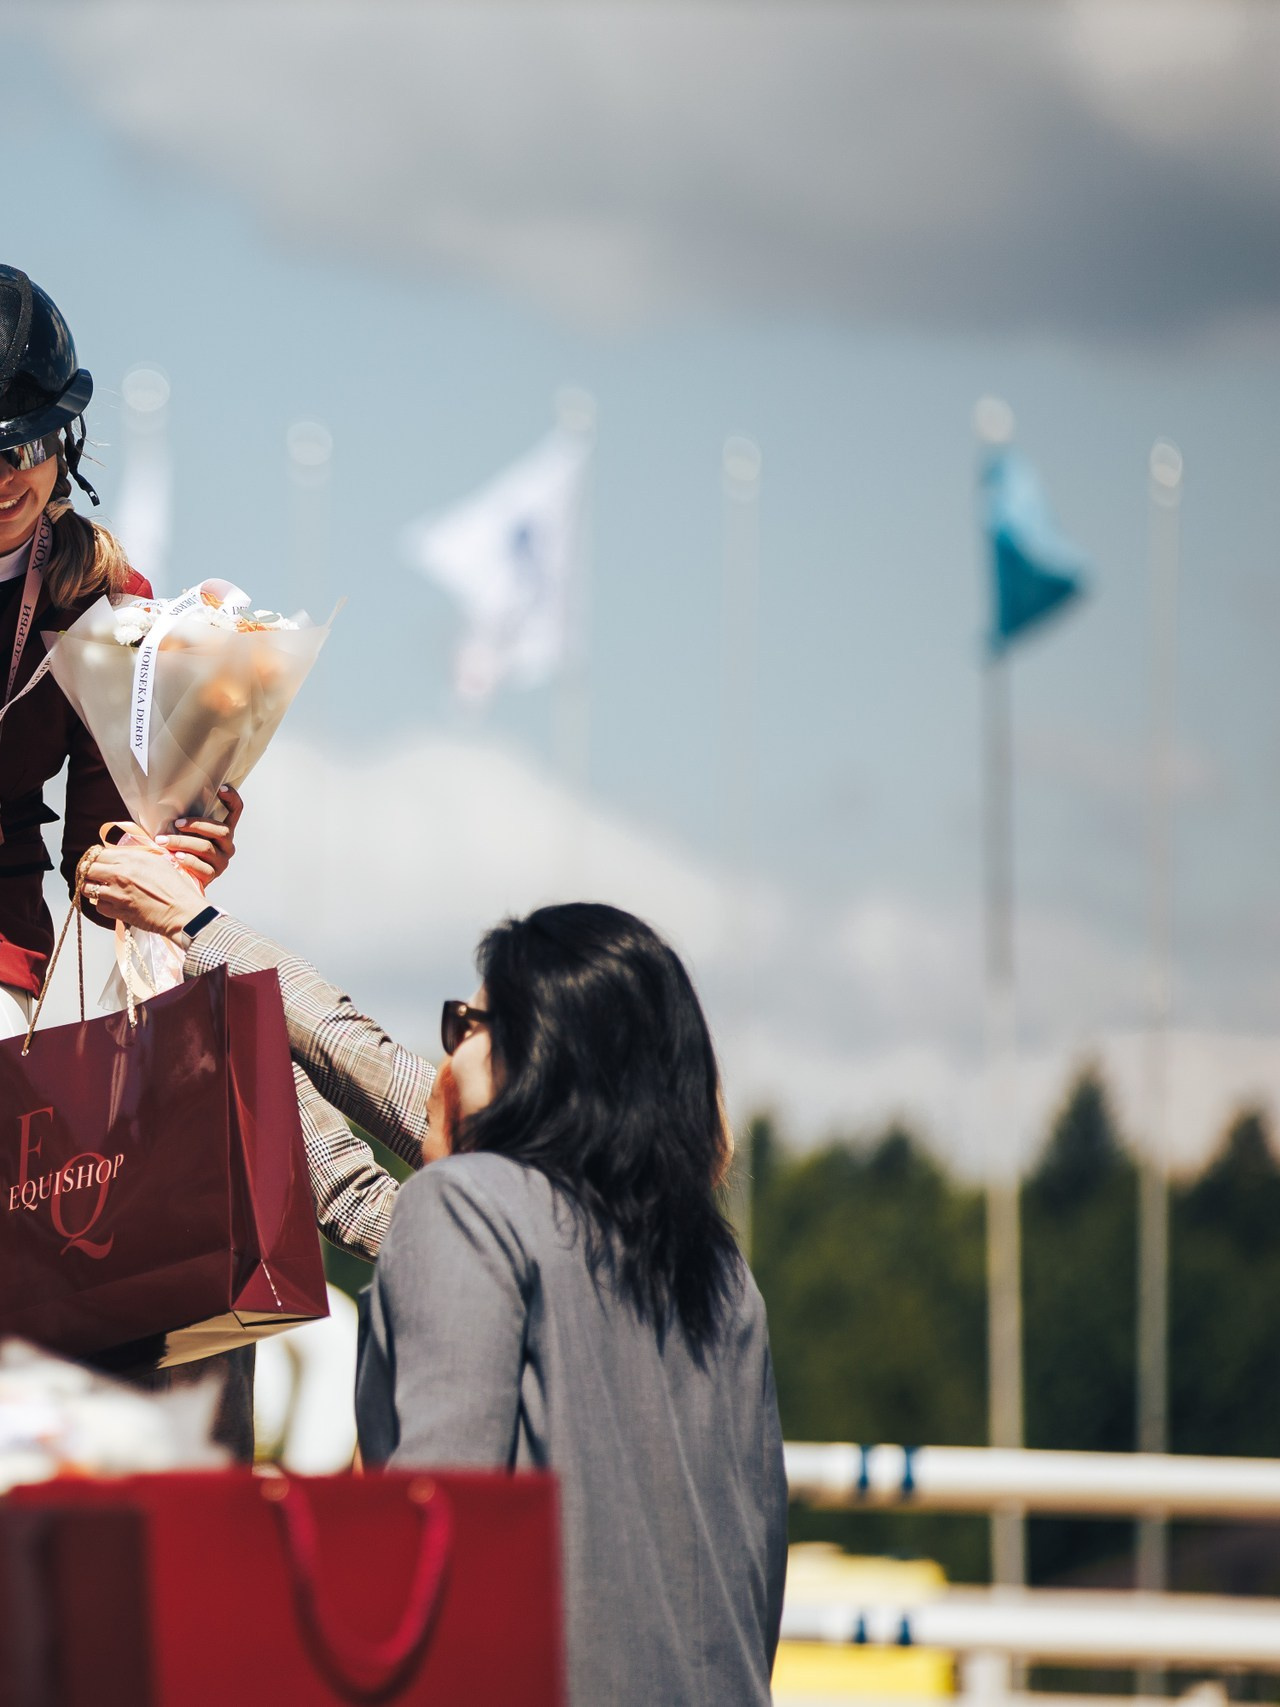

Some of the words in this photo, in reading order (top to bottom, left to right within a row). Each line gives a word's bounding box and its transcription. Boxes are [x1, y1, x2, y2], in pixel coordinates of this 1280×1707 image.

[13, 604, 32, 661] ДЕРБИ
[137, 646, 153, 704] HORSEKA
[135, 708, 145, 750] DERBY
[8, 1153, 125, 1212] EQUISHOP
